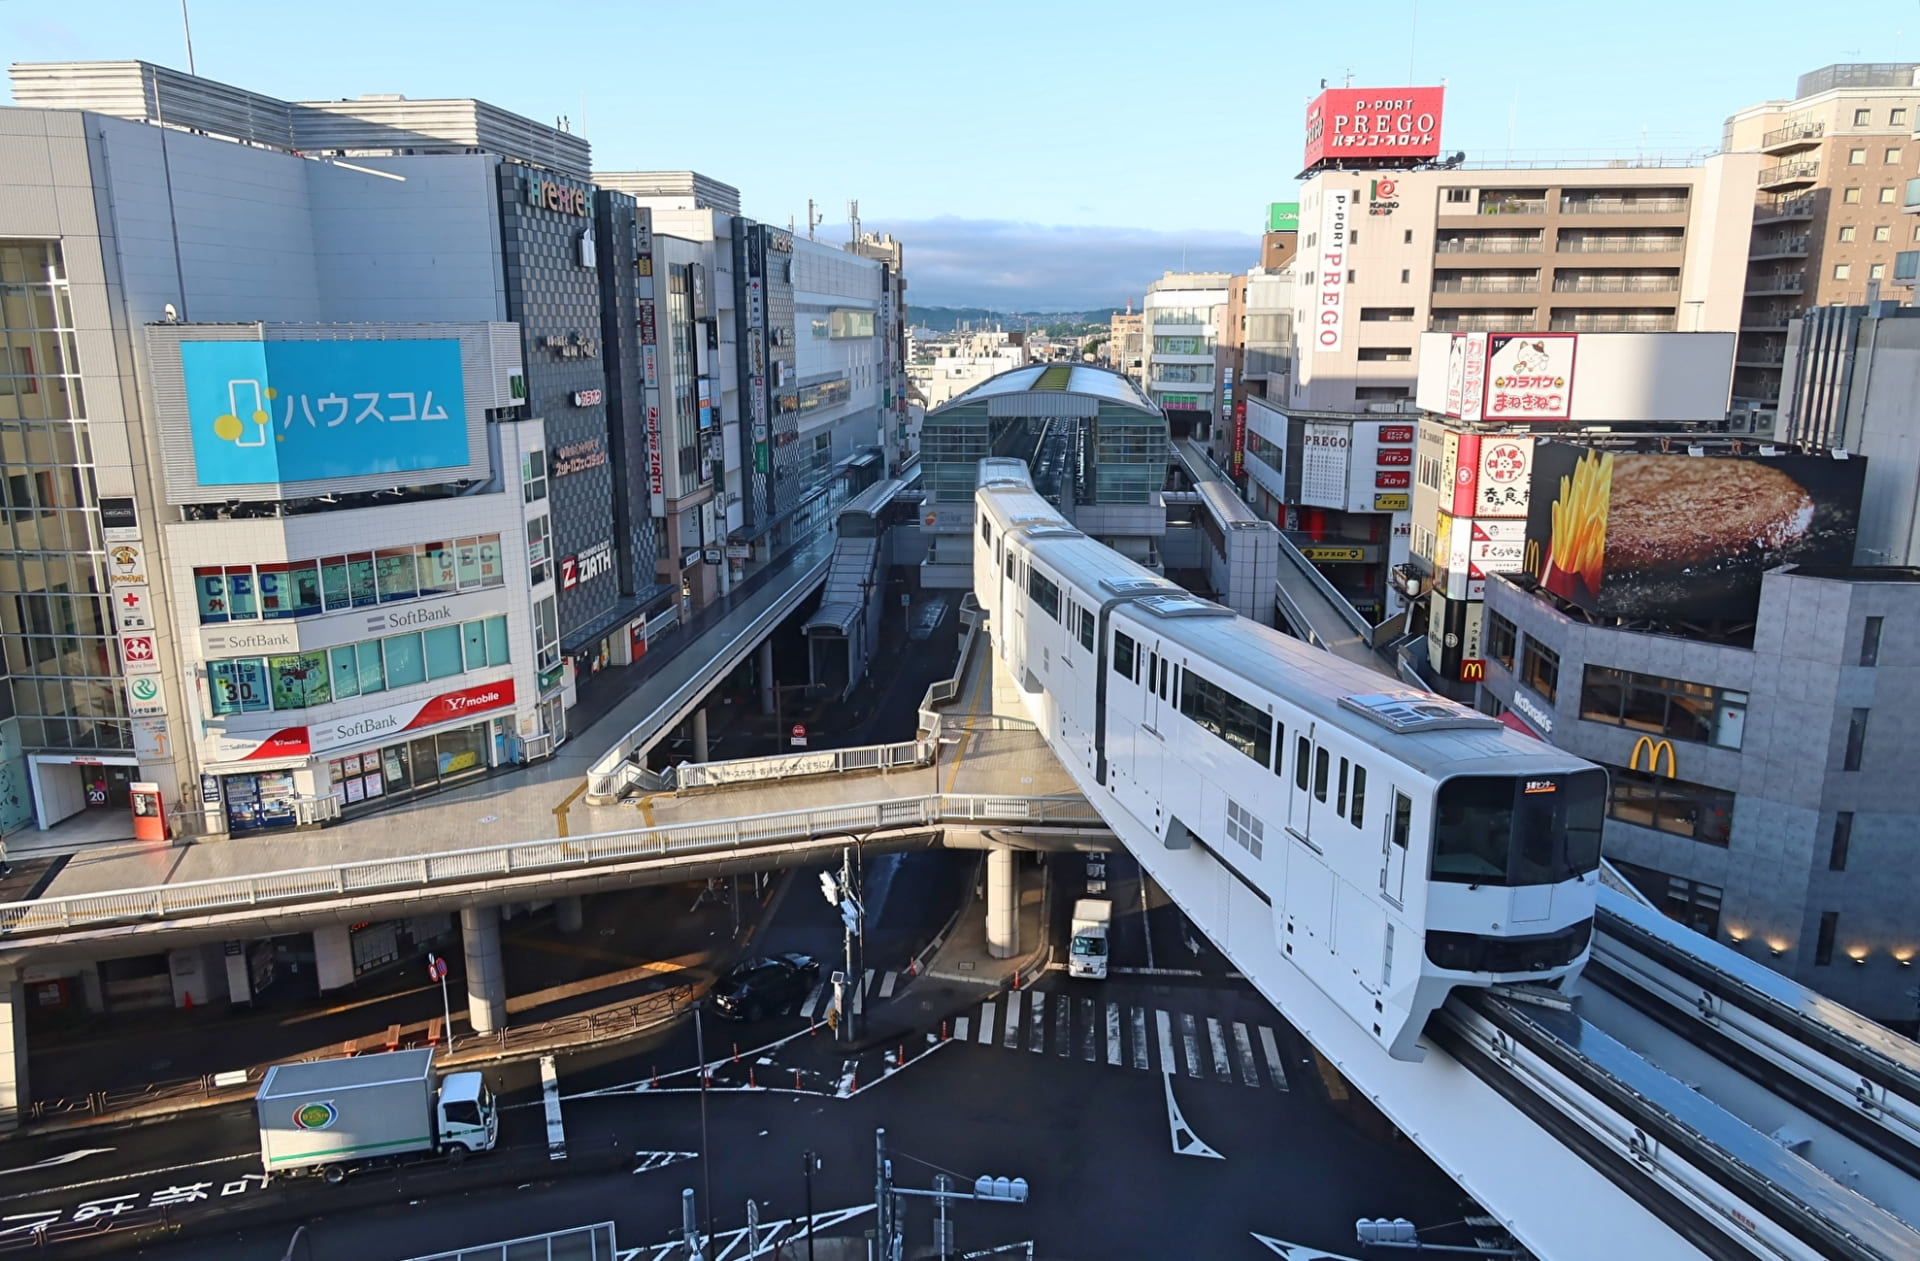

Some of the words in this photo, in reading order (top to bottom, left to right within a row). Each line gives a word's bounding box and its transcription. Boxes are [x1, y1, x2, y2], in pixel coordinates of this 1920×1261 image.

[1334, 114, 1436, 134] PREGO
[1332, 135, 1433, 146] パチンコ・スロット
[1320, 253, 1342, 346] PREGO
[1464, 340, 1483, 414] カラオケ
[1505, 376, 1555, 388] カラオケ
[284, 391, 449, 429] ハウスコム
[1493, 392, 1562, 412] まねきねこ
[1305, 435, 1347, 448] PREGO
[650, 453, 661, 494] ZIATH
[579, 549, 611, 583] ZIATH
[389, 605, 452, 628] SoftBank
[229, 634, 290, 649] SoftBank
[445, 692, 499, 711] Y!mobile
[337, 715, 397, 740] SoftBank
[89, 791, 105, 802] 20
